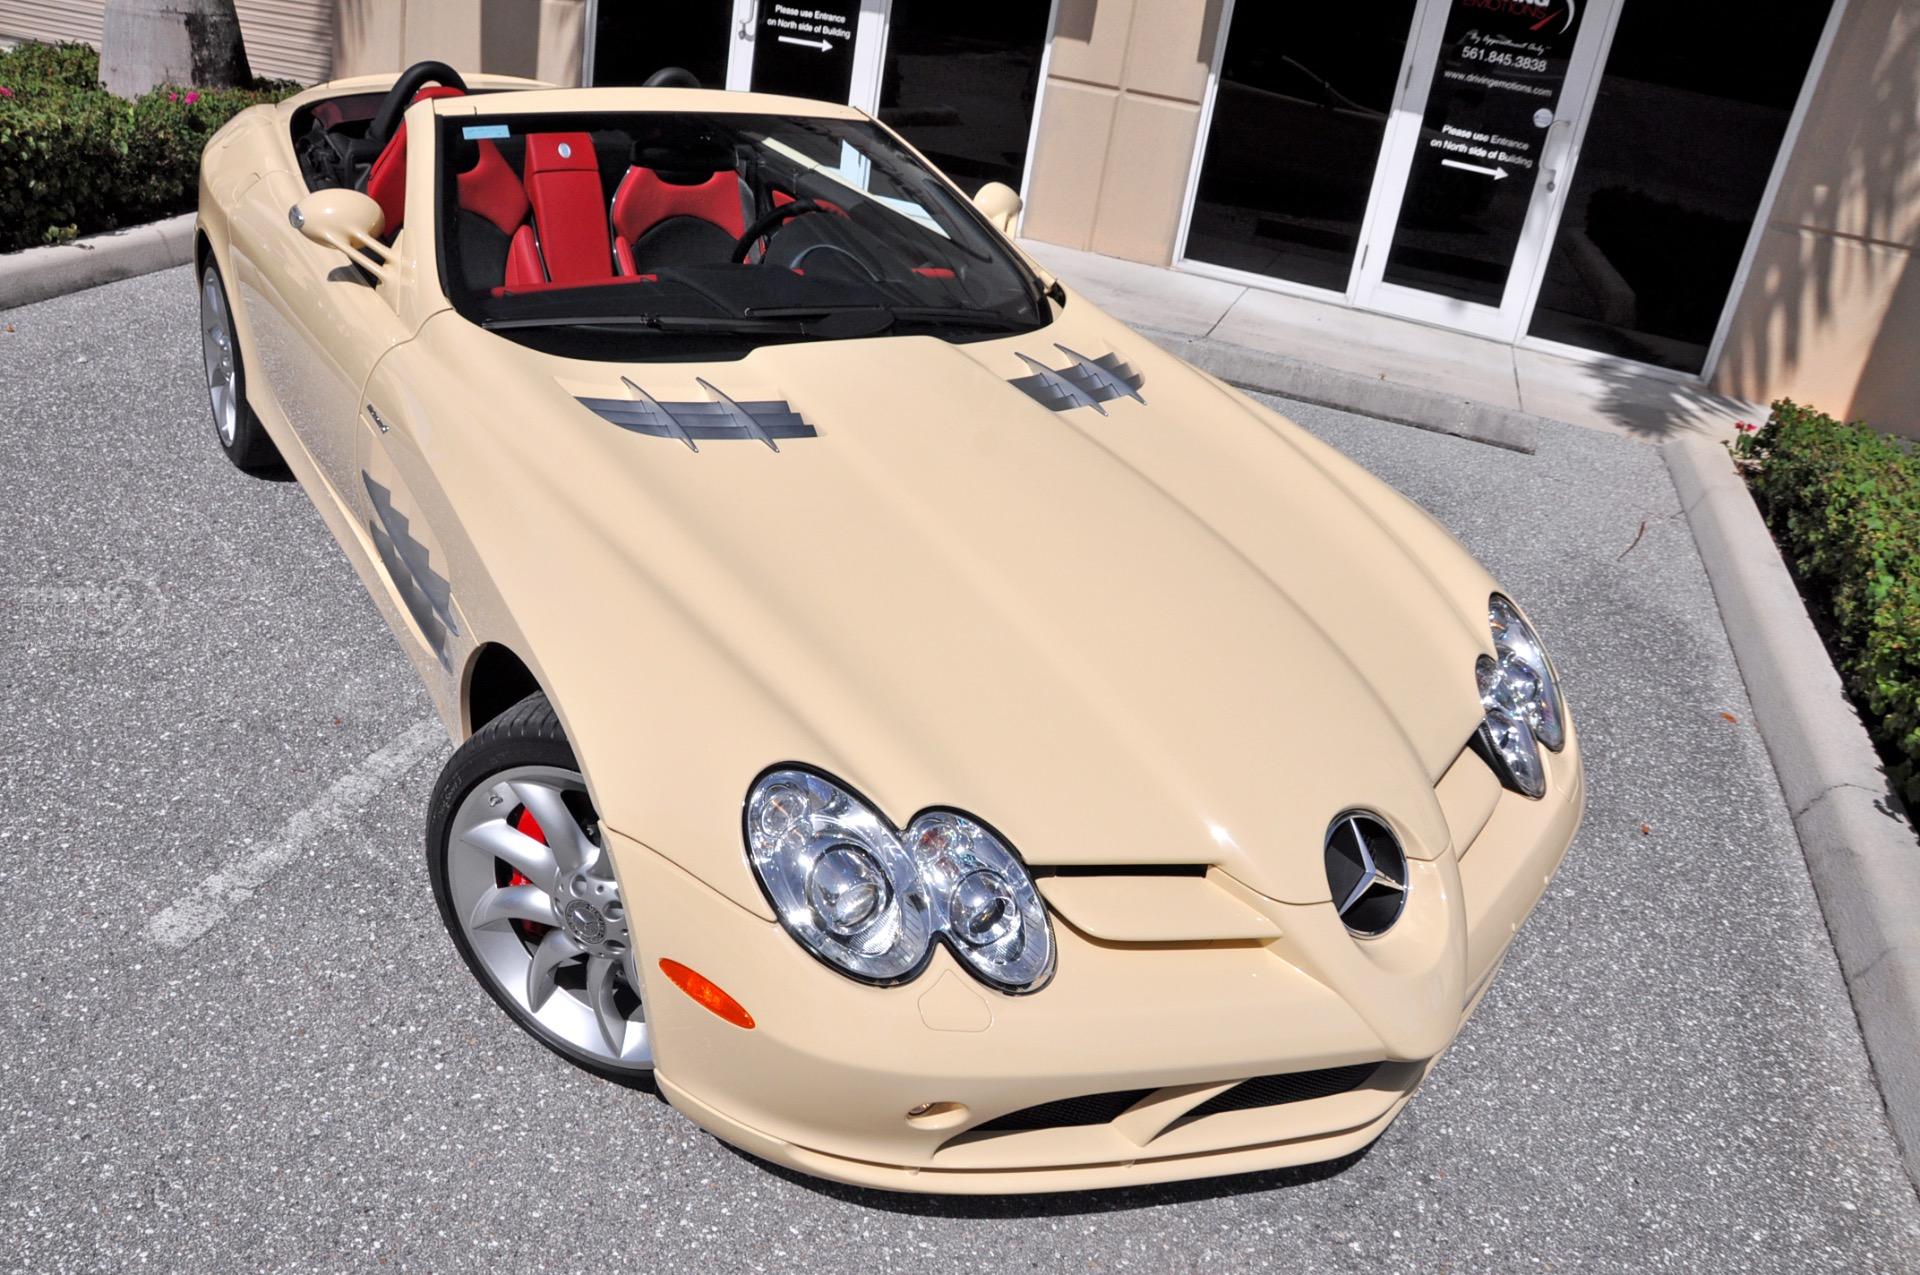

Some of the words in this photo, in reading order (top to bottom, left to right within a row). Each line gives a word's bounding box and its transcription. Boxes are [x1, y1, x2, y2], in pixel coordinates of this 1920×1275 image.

[774, 4, 799, 16] Please
[800, 9, 813, 18] use
[814, 10, 846, 24] Entrance
[767, 18, 777, 26] on
[777, 19, 797, 29] North
[798, 22, 813, 32] side
[813, 25, 822, 33] of
[822, 26, 851, 40] Building
[1461, 46, 1547, 73] 561.845.3838
[1443, 70, 1552, 97] www.drivingemotions.com
[1442, 124, 1472, 139] Please
[1472, 132, 1490, 142] use
[1490, 134, 1530, 151] Entrance
[1430, 138, 1442, 148] on
[1442, 140, 1468, 154] North
[1468, 146, 1487, 158] side
[1487, 150, 1498, 159] of
[1497, 151, 1534, 169] Building
